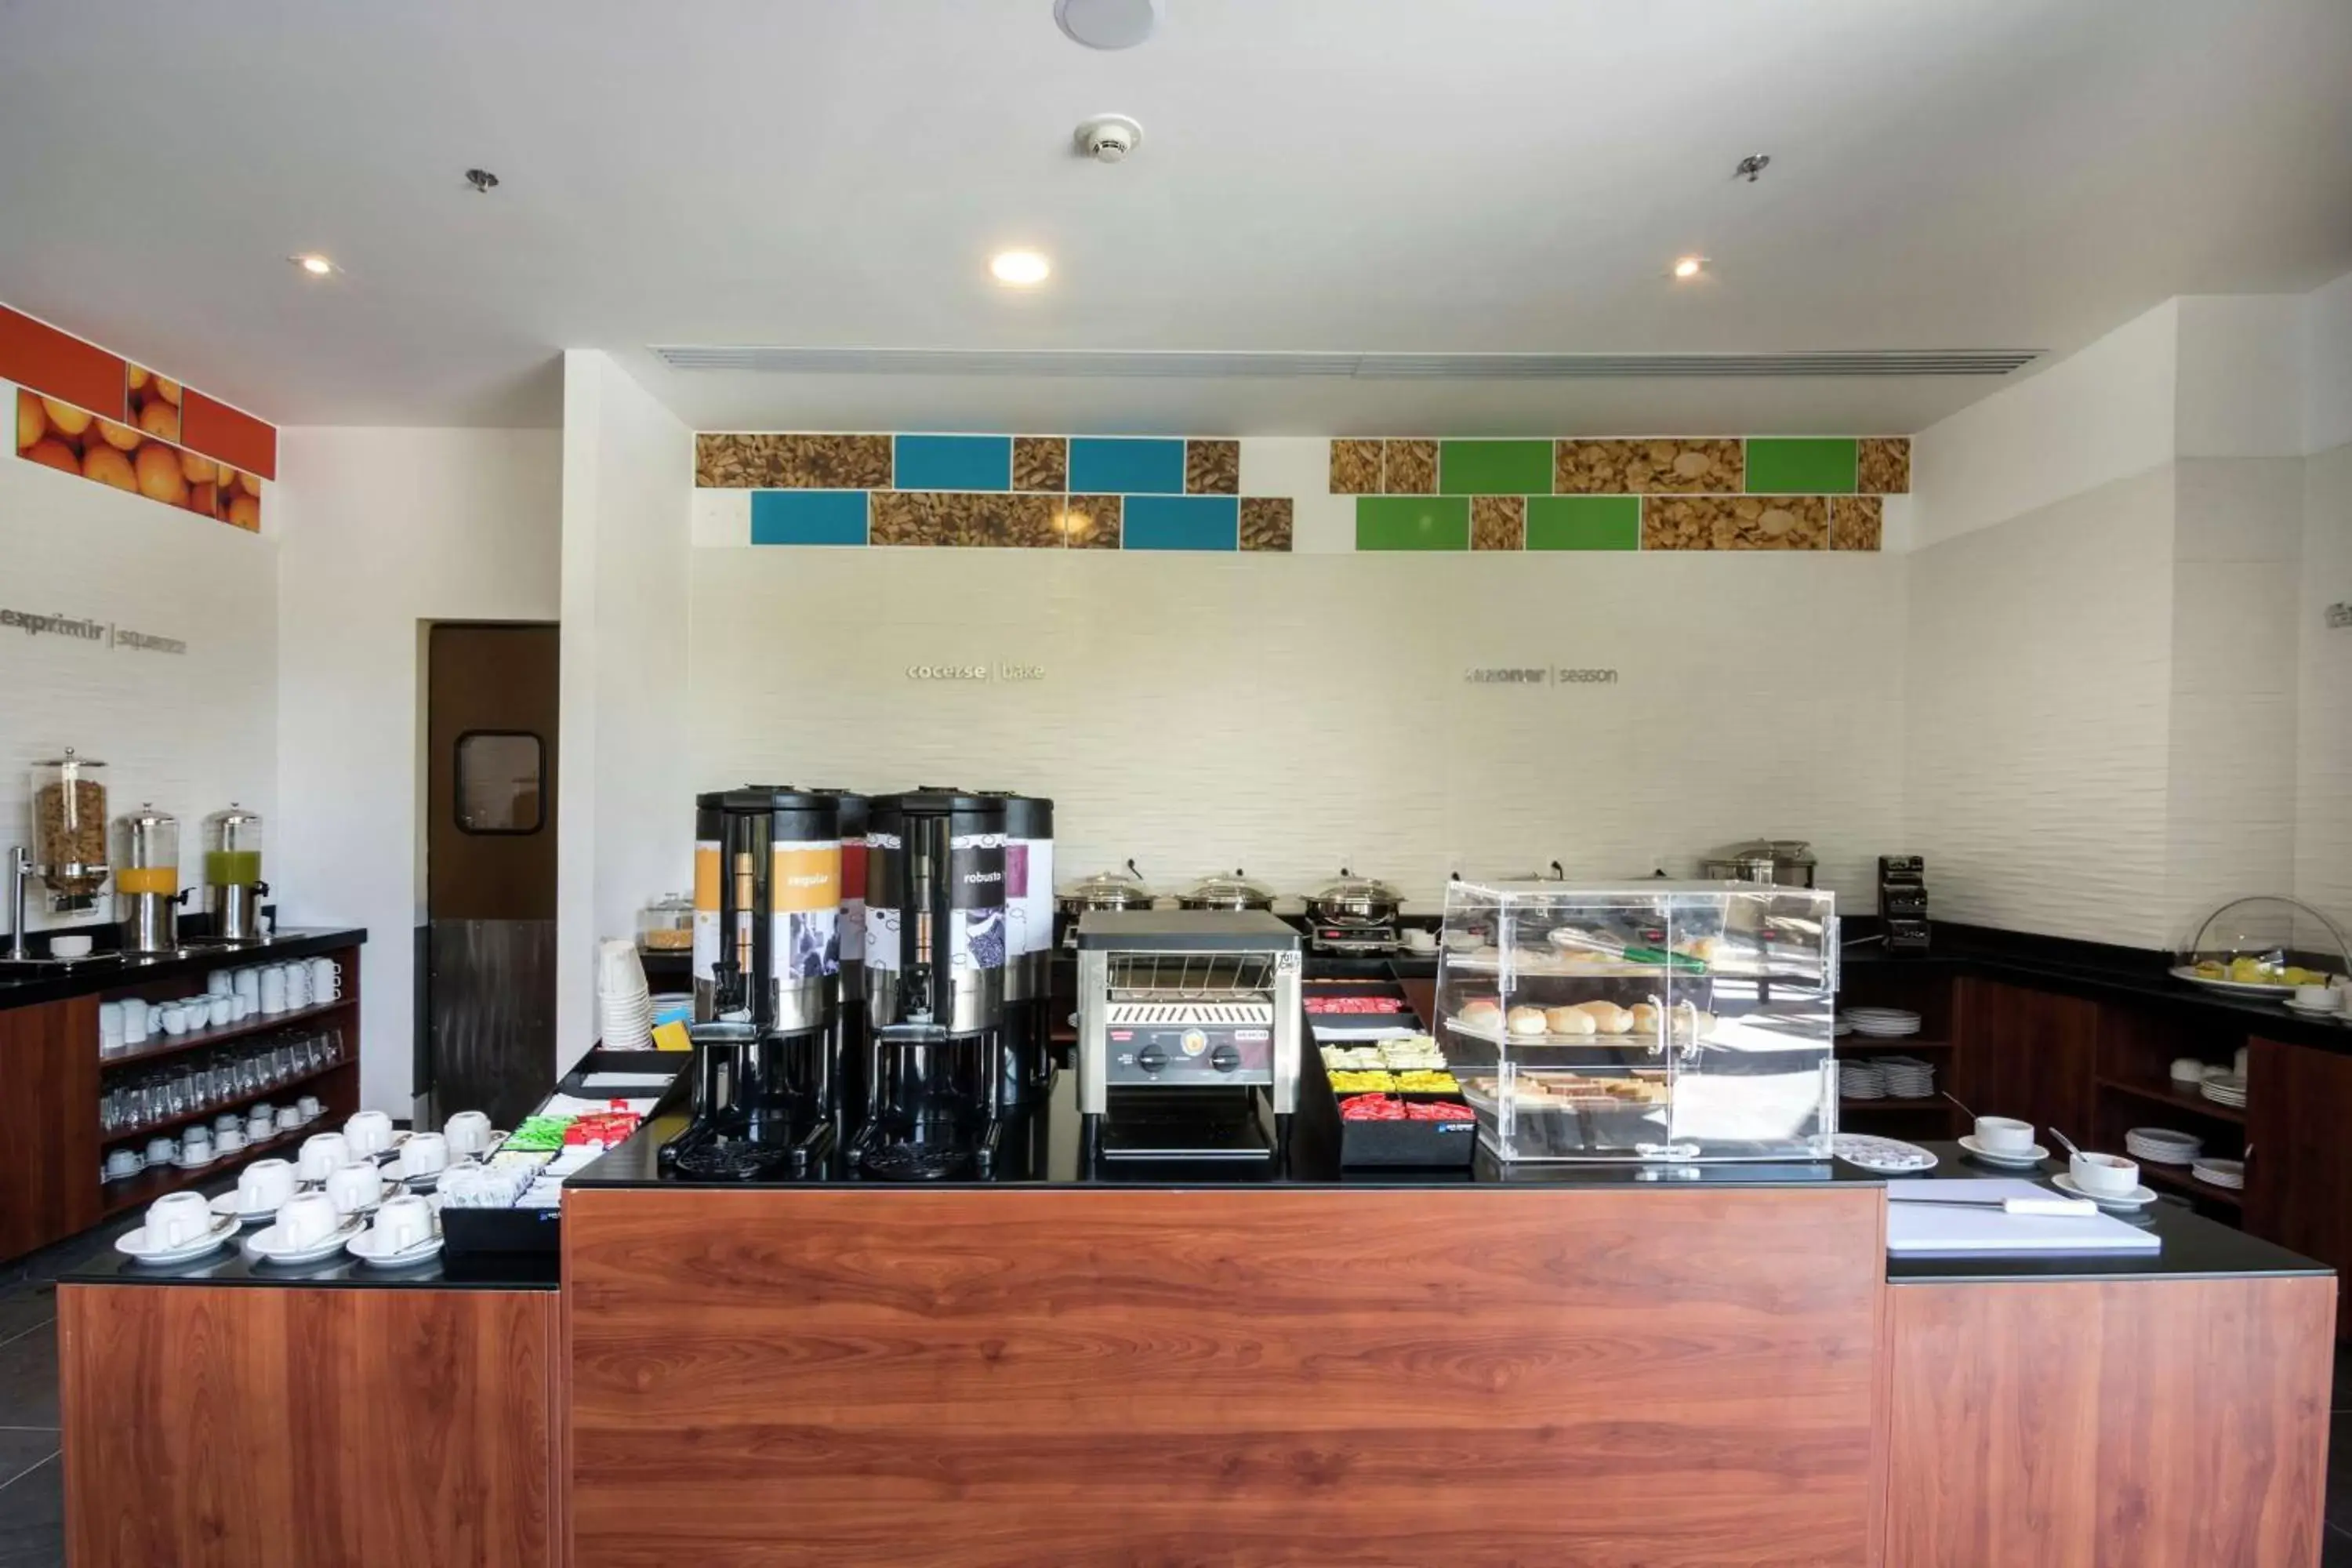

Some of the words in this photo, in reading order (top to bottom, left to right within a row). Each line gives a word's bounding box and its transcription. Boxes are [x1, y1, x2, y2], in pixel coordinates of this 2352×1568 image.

[0, 608, 105, 640] exprimir
[906, 664, 986, 680] cocerse
[1001, 661, 1044, 680] bake
[1559, 668, 1618, 684] season
